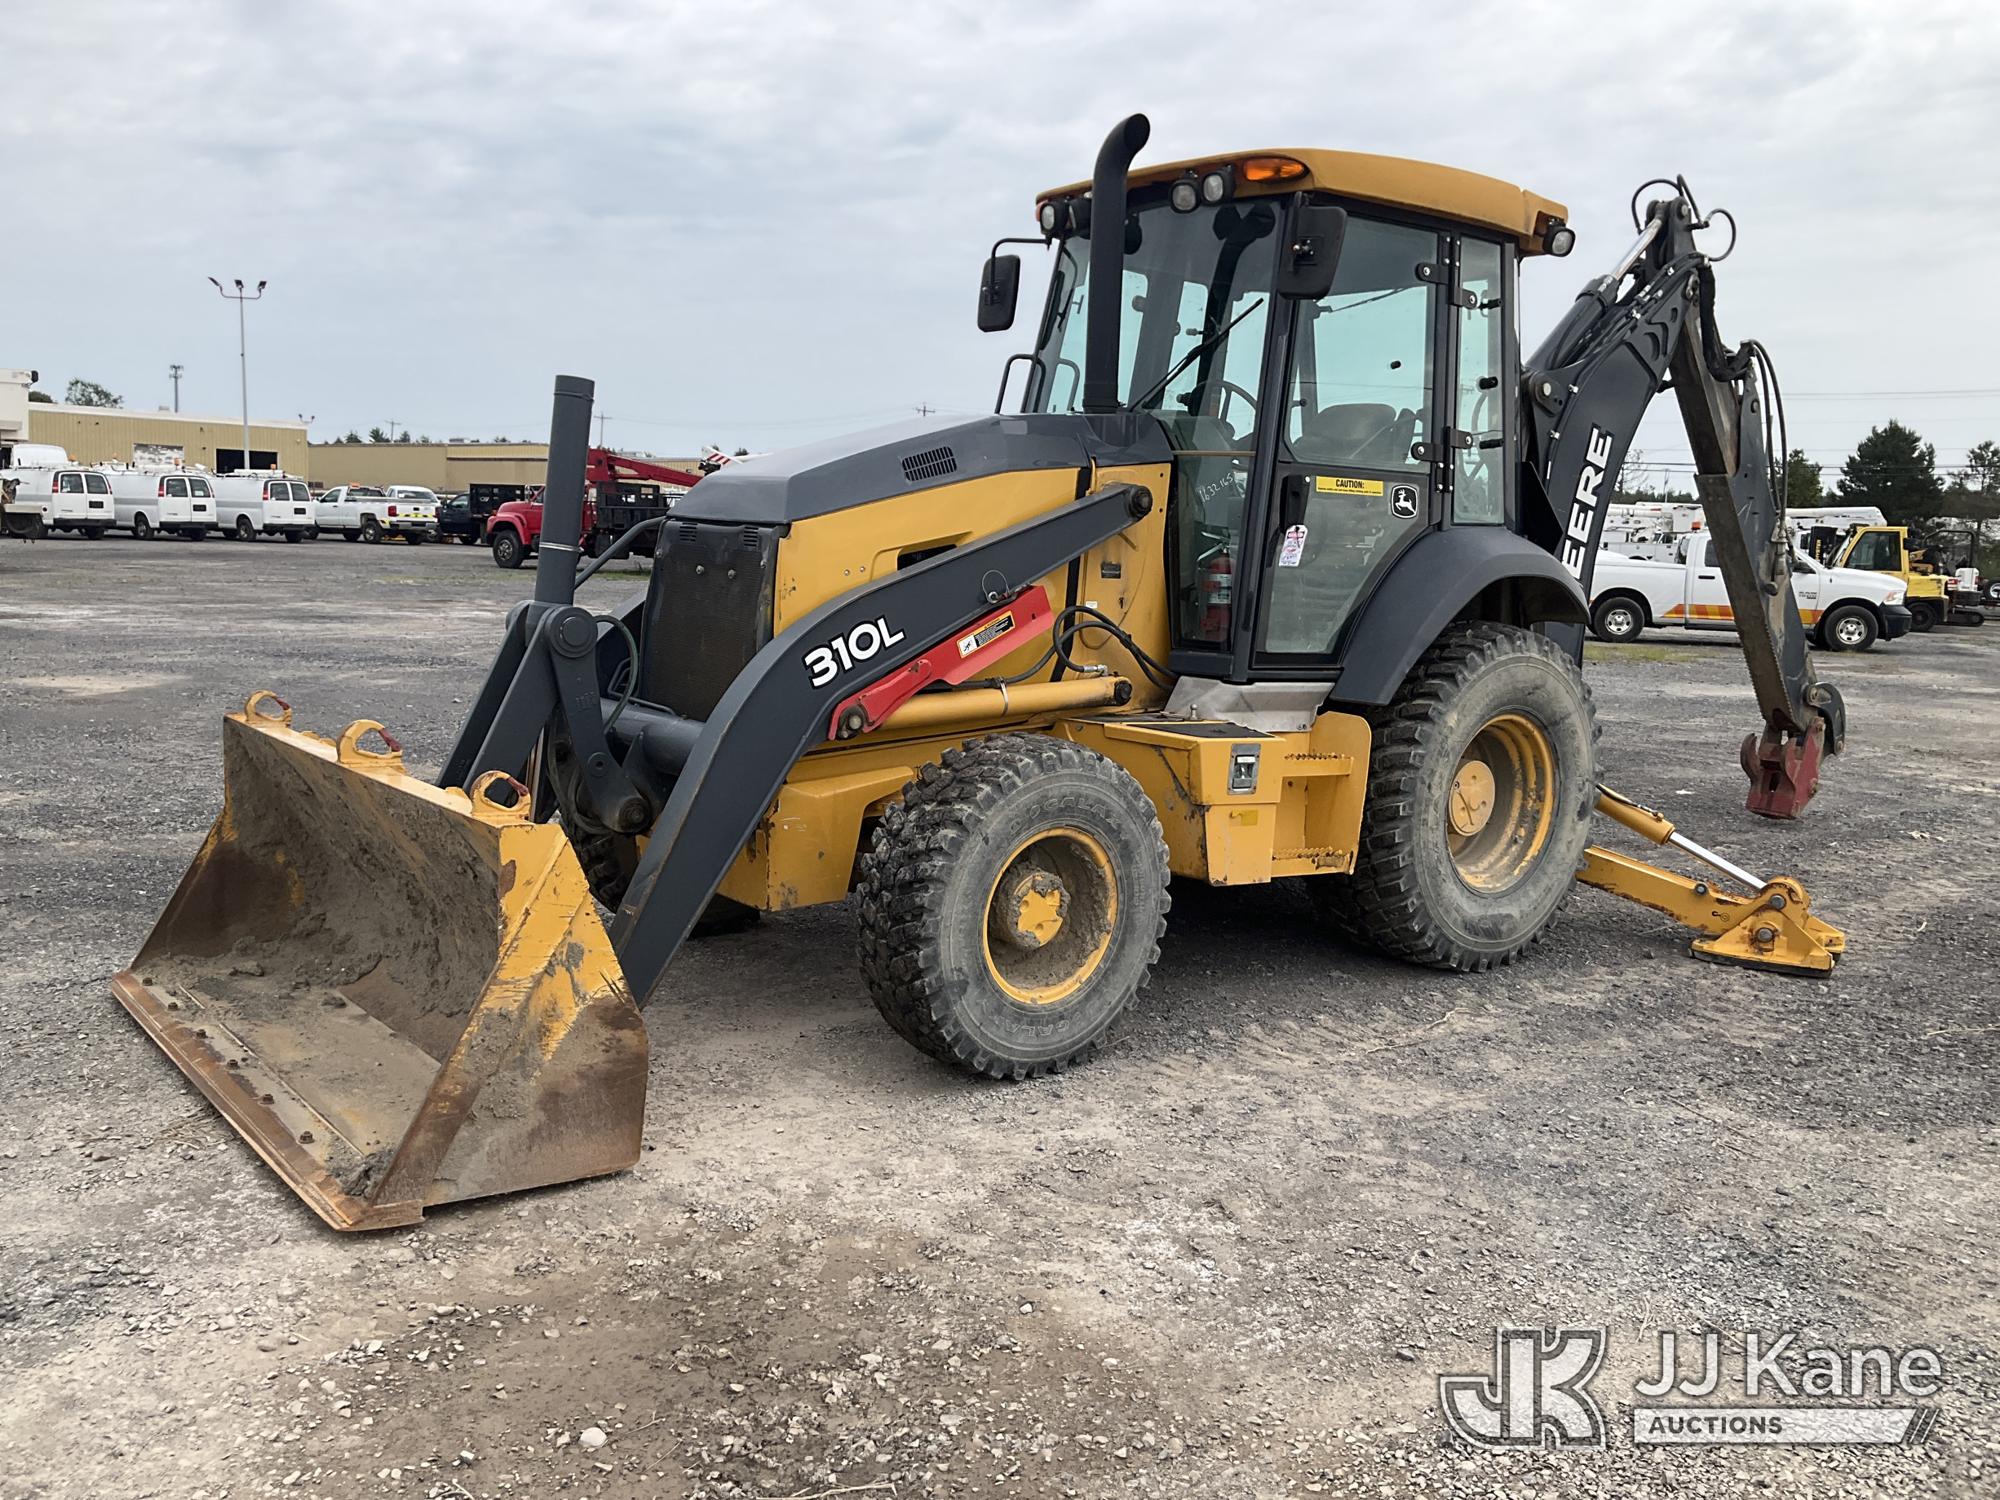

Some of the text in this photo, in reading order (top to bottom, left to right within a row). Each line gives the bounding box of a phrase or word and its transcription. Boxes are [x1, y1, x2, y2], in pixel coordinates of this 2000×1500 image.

[1335, 478, 1365, 489] CAUTION:
[1562, 428, 1613, 582] EERE
[804, 616, 905, 688] 310L
